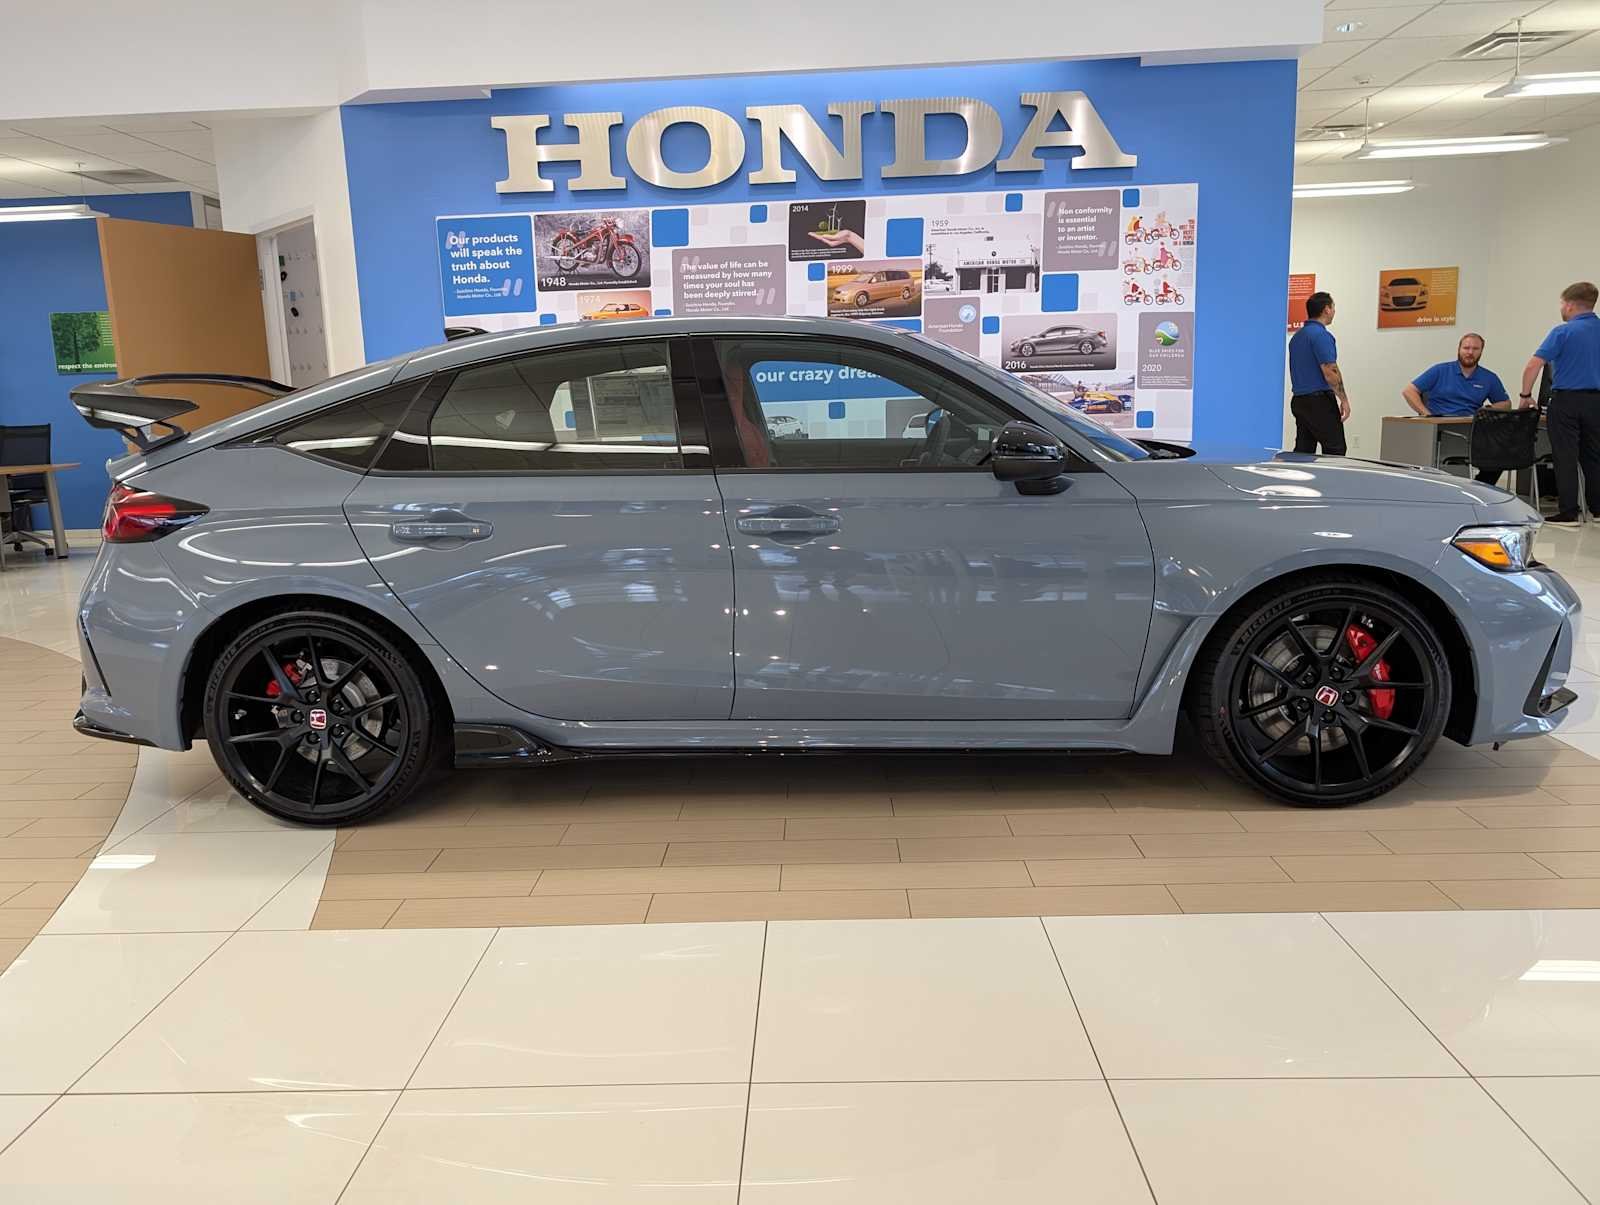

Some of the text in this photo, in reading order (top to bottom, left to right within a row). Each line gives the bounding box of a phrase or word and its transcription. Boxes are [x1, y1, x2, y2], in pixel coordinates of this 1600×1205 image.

[491, 91, 1138, 194] HONDA
[792, 205, 809, 213] 2014
[1075, 206, 1113, 215] conformity
[931, 219, 950, 228] 1959
[1065, 215, 1097, 223] essential
[449, 233, 519, 246] Our products
[450, 246, 523, 259] will speak the
[451, 260, 511, 272] truth about
[682, 263, 697, 271] The
[698, 262, 719, 270] value
[719, 261, 728, 269] of
[729, 261, 742, 269] life
[758, 260, 769, 268] be
[831, 264, 854, 274] 1999
[452, 273, 490, 285] Honda.
[683, 270, 773, 281] measured by how many
[540, 276, 567, 288] 1948
[683, 279, 755, 290] times your soul has
[683, 288, 760, 299] been deeply stirred.
[1005, 360, 1027, 370] 2016
[1141, 363, 1163, 372] 2020
[756, 365, 881, 384] our crazy drea
